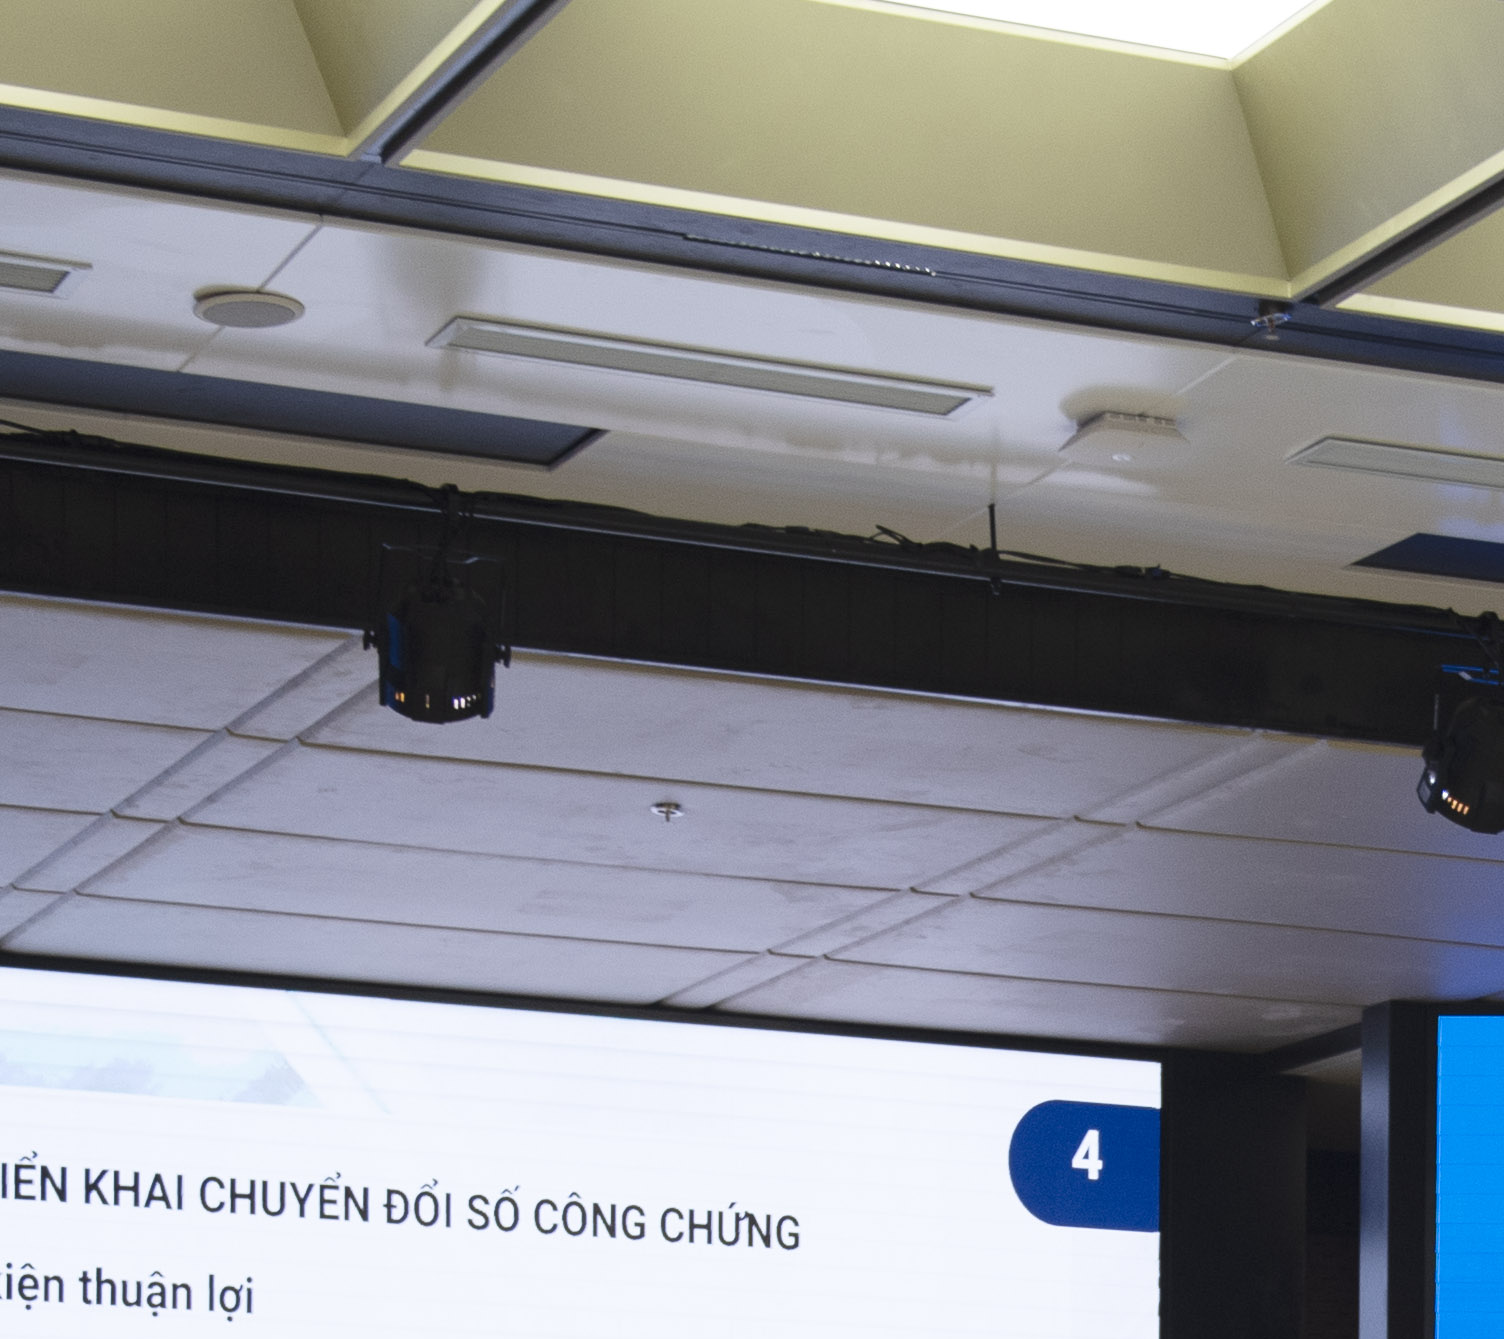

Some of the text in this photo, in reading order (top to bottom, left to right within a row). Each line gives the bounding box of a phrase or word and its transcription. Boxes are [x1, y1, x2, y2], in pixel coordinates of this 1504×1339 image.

[1072, 1129, 1103, 1180] 4
[85, 1168, 183, 1210] KHAI
[200, 1172, 369, 1222] CHUYỂN
[383, 1179, 451, 1227] ĐỔI
[468, 1186, 519, 1232] SỐ
[534, 1192, 645, 1240] CÔNG
[661, 1202, 799, 1250] CHỨNG
[79, 1267, 191, 1317] thuận
[209, 1274, 252, 1322] lợi
